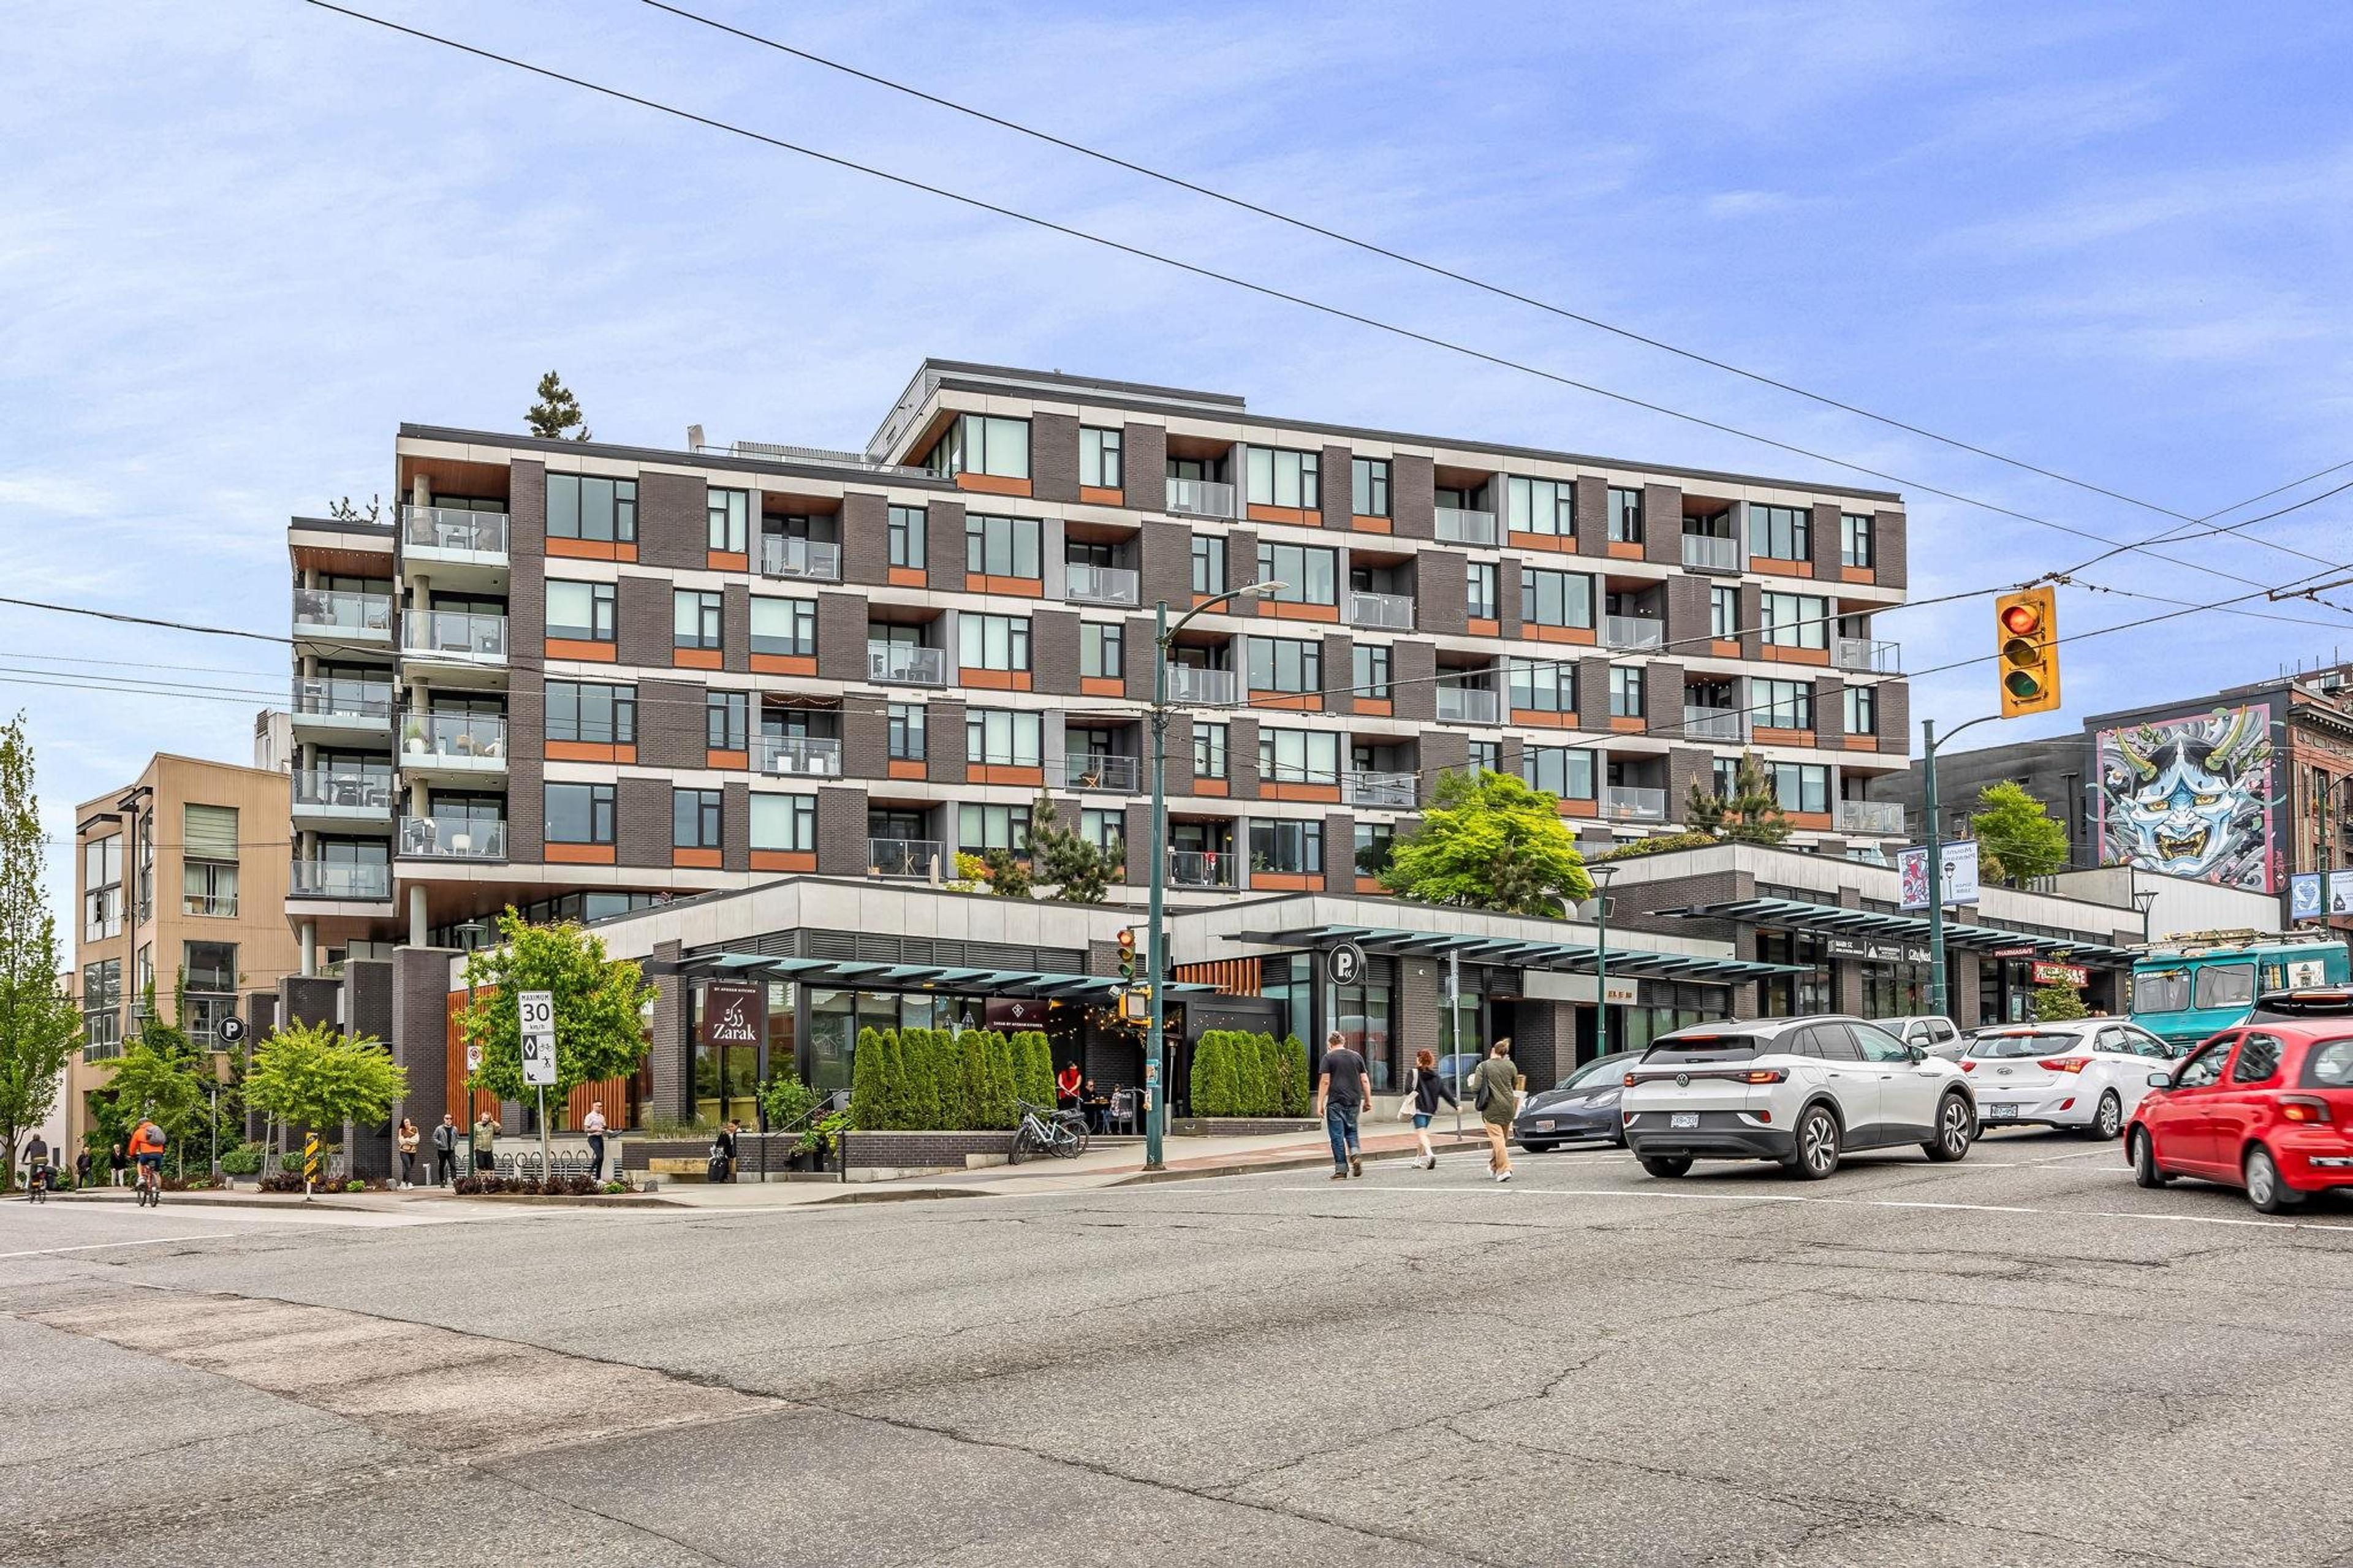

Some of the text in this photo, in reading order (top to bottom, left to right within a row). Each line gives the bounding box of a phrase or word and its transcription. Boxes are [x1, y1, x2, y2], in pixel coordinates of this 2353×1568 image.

[1995, 948, 2033, 956] PHARMASAVE
[1338, 953, 1352, 976] P
[523, 1003, 550, 1022] 30
[226, 1022, 238, 1037] P
[713, 1023, 757, 1040] Zarak
